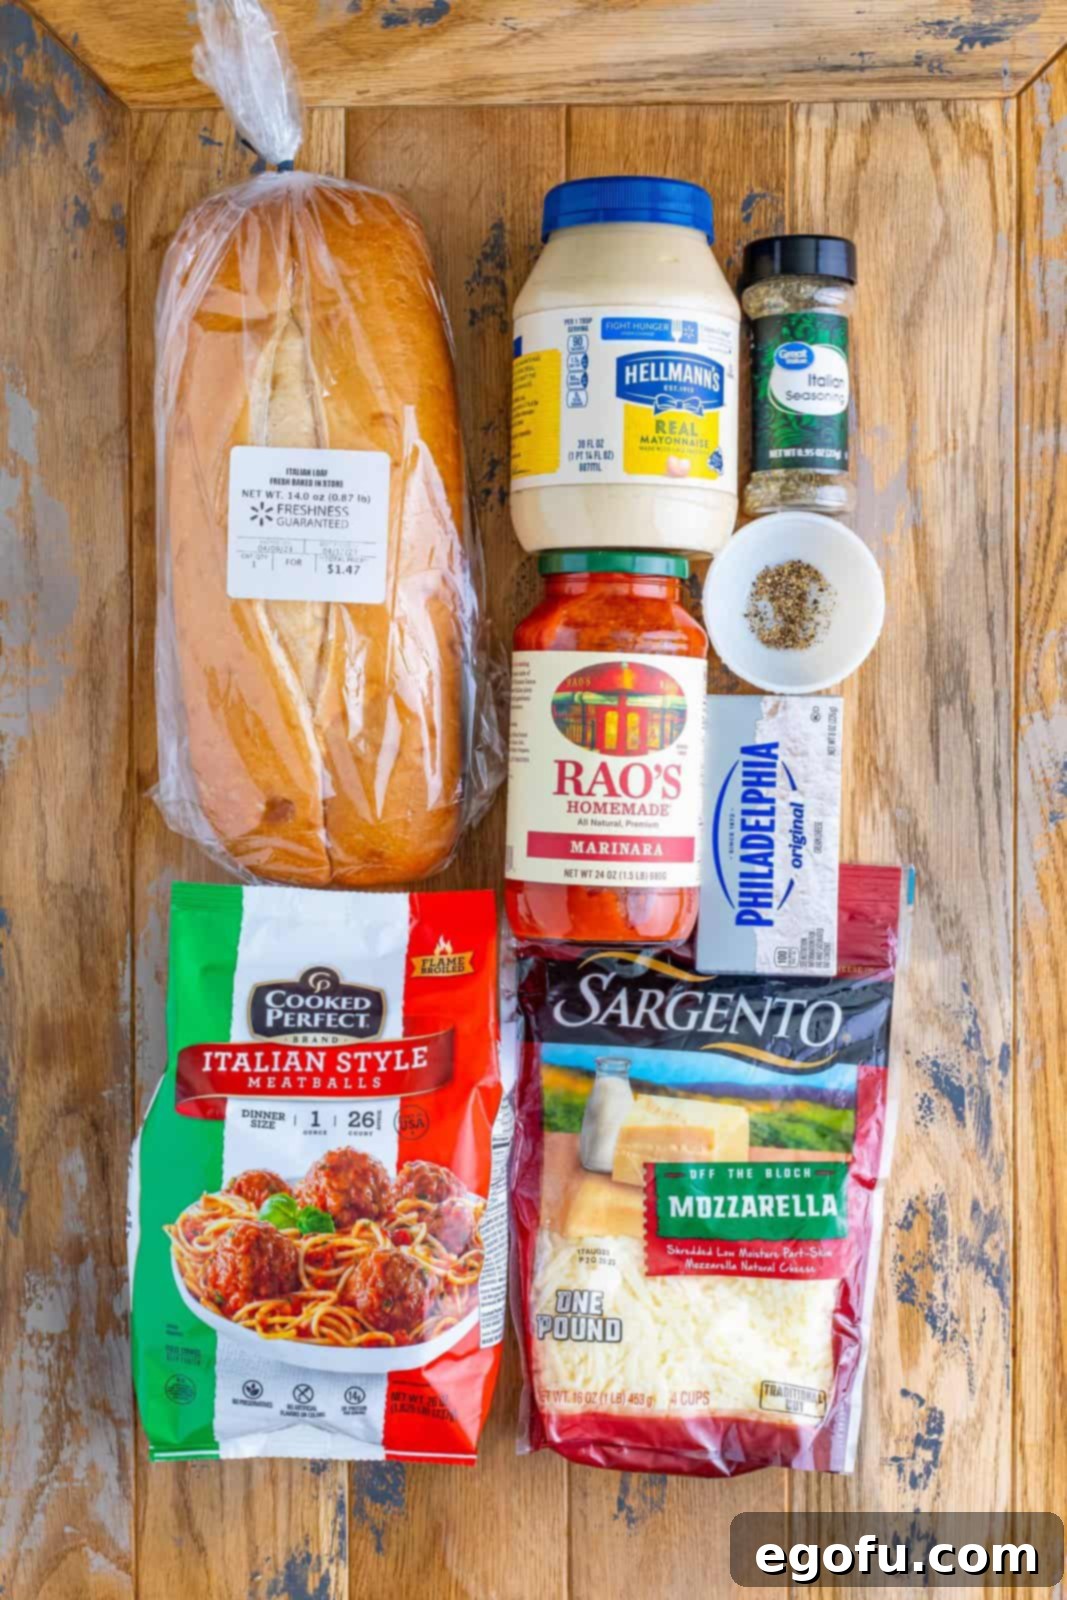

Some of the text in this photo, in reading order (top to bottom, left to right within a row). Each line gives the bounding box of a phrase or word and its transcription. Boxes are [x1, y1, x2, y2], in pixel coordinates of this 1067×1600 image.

[605, 321, 669, 331] FIGHT HUNGER
[625, 362, 720, 392] HELLMANN'S
[808, 373, 844, 388] Italian
[785, 390, 845, 406] Seasoning
[655, 419, 698, 437] REAL
[640, 435, 708, 448] MAYONNAISE
[286, 467, 328, 477] ITALIAN LOAF
[269, 477, 290, 486] FRESH
[291, 478, 313, 487] BAKED
[241, 489, 261, 498] NET
[266, 490, 284, 499] WT.
[287, 492, 310, 500] 14.0
[328, 493, 354, 503] (0.87
[357, 494, 371, 504] lb)
[277, 503, 350, 517] FRESHNESS
[276, 517, 350, 529] GUARANTEED
[285, 558, 302, 566] FOR
[327, 563, 360, 575] $1.47
[552, 759, 682, 799] RAO'S
[566, 801, 669, 816] HOMEMADE
[577, 818, 660, 828] All Natural, Premium
[734, 741, 780, 927] PHILADELPHIA
[787, 802, 808, 869] original
[569, 840, 663, 856] MARINARA
[564, 868, 578, 878] NET
[580, 869, 593, 879] WT
[595, 870, 605, 880] 24
[606, 870, 617, 880] OZ
[619, 871, 634, 881] (1.5
[422, 956, 465, 967] FLAME
[777, 950, 787, 964] 100
[421, 966, 465, 974] BROILED
[265, 990, 372, 1011] COOKED
[553, 972, 843, 1048] SARGENTO
[265, 1008, 370, 1029] PERFECT
[292, 1036, 339, 1044] BRAND
[202, 1046, 429, 1073] ITALIAN STYLE
[248, 1077, 382, 1090] MEATBALLS
[241, 1109, 286, 1122] DINNER
[310, 1110, 321, 1127] 1
[348, 1110, 375, 1129] 26
[250, 1119, 276, 1130] SIZE
[399, 1118, 425, 1131] USA
[690, 1168, 716, 1180] OFF
[728, 1168, 753, 1179] THE
[667, 1194, 838, 1219] MOZZARELLA
[666, 1244, 833, 1259] Shredded Low Moisture Part-Skim
[685, 1259, 816, 1273] Mozzarella Natural Cheese
[556, 1289, 604, 1316] ONE
[536, 1315, 622, 1343] POUND
[585, 1391, 597, 1404] OZ
[611, 1391, 626, 1405] LB)
[628, 1392, 646, 1405] 453
[680, 1391, 711, 1406] CUPS
